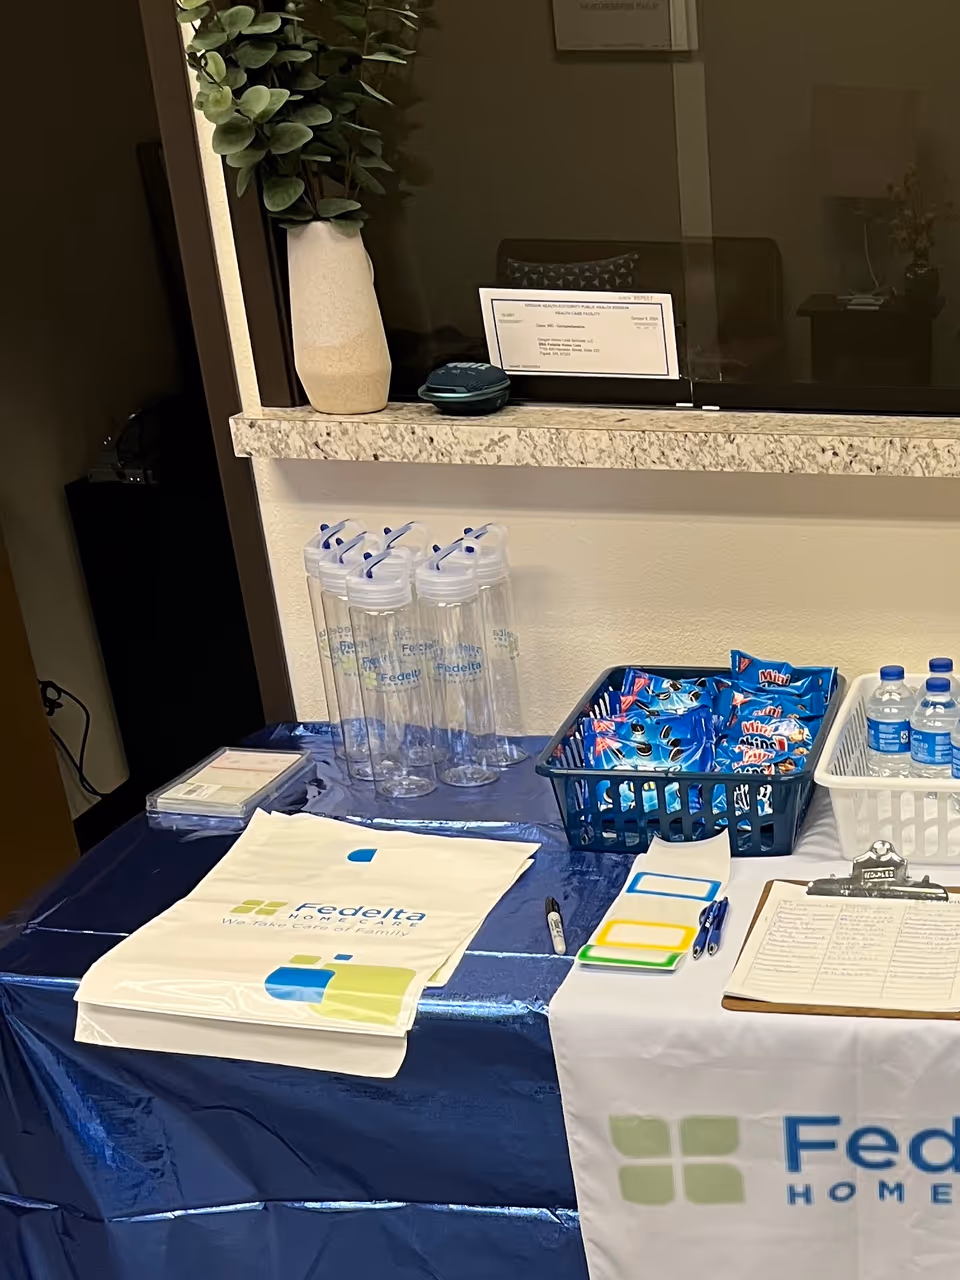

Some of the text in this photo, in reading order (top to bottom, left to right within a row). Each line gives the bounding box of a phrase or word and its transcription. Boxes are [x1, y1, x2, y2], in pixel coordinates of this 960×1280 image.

[759, 669, 791, 686] Mini
[741, 720, 774, 738] Mini
[288, 914, 419, 928] HOME CARE
[295, 903, 426, 922] Fedelta
[221, 918, 243, 926] We
[249, 920, 287, 928] Take
[292, 923, 329, 932] Care
[354, 927, 410, 938] Family
[787, 1180, 954, 1206] HOME
